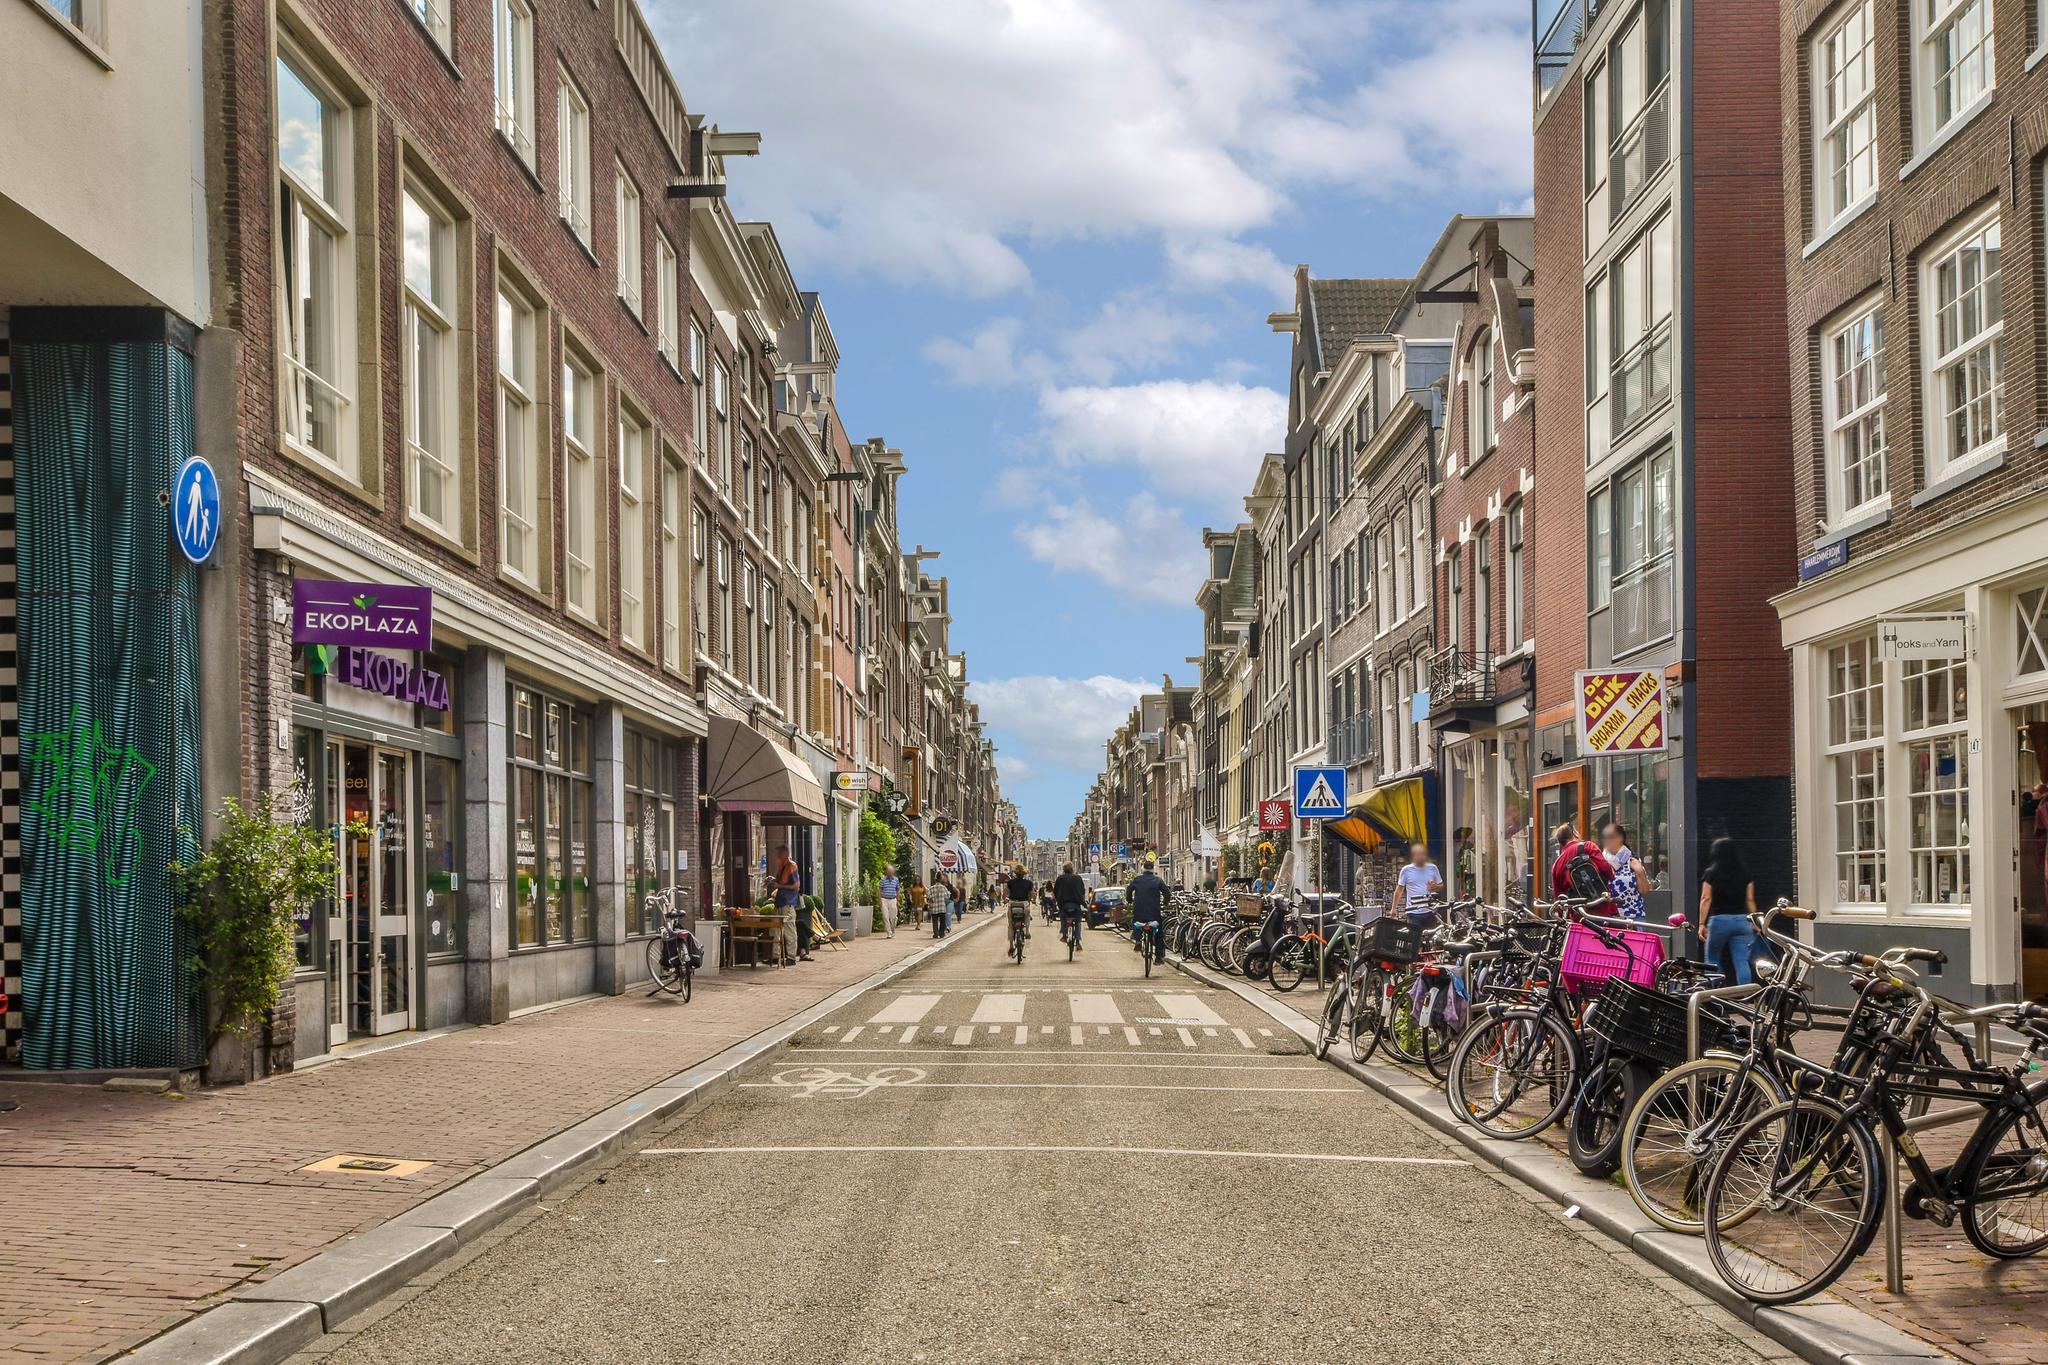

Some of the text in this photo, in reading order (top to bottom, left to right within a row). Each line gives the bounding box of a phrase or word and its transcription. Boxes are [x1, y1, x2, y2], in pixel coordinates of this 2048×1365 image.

[305, 611, 419, 635] EKOPLAZA
[1936, 638, 1959, 647] Yarn
[346, 646, 451, 711] EKOPLAZA
[1584, 675, 1604, 697] DE
[1585, 674, 1627, 719] DIJK
[1589, 708, 1627, 751] SHOARMA
[1626, 672, 1658, 709] SNACKS
